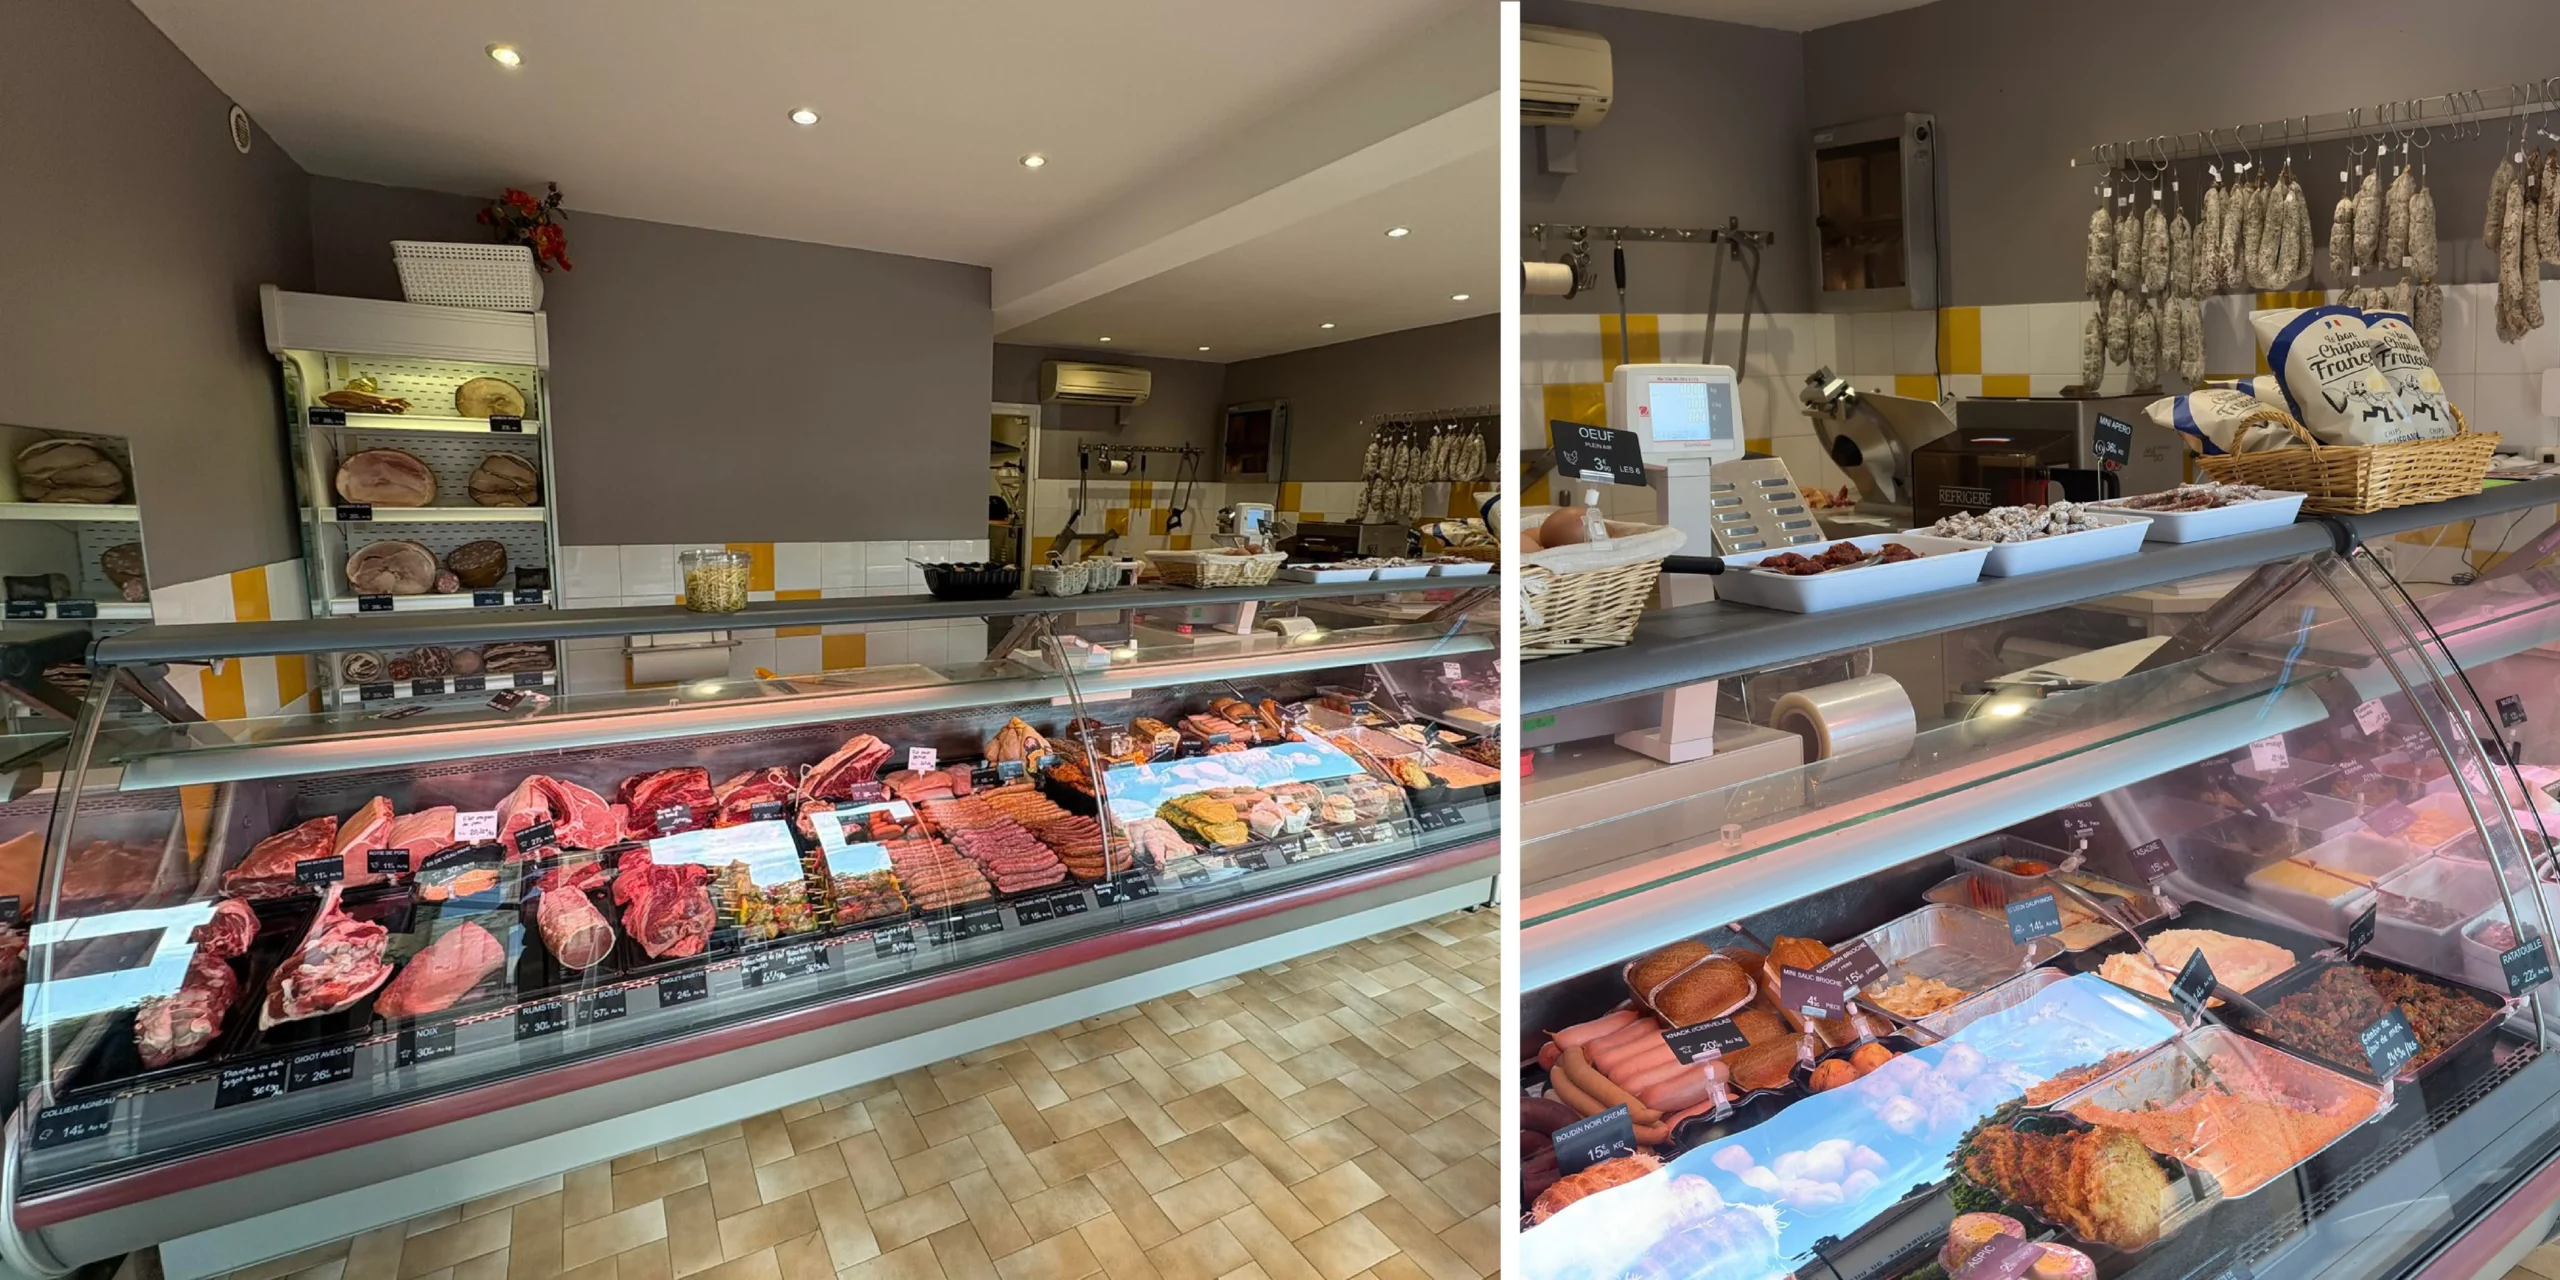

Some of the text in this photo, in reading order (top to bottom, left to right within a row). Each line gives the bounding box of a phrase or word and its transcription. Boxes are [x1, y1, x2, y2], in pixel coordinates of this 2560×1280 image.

[2336, 331, 2357, 343] bon
[2318, 339, 2371, 359] Chipsie
[2309, 353, 2374, 381] Franç
[2099, 415, 2131, 435] MINI APERO
[2429, 427, 2445, 435] CHIPS
[1578, 427, 1615, 442] OEUF
[2384, 428, 2402, 438] CHIPS
[1584, 441, 1602, 449] PLEIN
[1619, 465, 1634, 474] LES
[1635, 467, 1641, 475] 6
[1939, 489, 1992, 506] REFRIGERE
[2132, 842, 2160, 858] LASAGNE
[1816, 942, 1867, 974] UCISSON BRIOCHE
[2502, 938, 2543, 965] RATATOUILLE
[1783, 968, 1843, 987] MINI SAUC BRIOCHE
[598, 987, 624, 999] BOEUF
[522, 1001, 563, 1016] RUMSTEK
[1825, 1002, 1841, 1010] PIECE
[2381, 1019, 2391, 1028] de
[416, 1027, 439, 1039] NOIX
[1665, 1028, 1691, 1039] KNACK
[2380, 1034, 2388, 1044] de
[294, 1045, 355, 1065] GIGOT AVEC OS
[41, 1096, 117, 1119] COLLIER AGNEAU
[87, 1124, 98, 1132] Au
[98, 1122, 109, 1131] kg
[1555, 1106, 1628, 1143] BOUDIN NOIR CREME
[1612, 1140, 1625, 1151] KG
[1967, 1244, 1996, 1268] ASPIC
